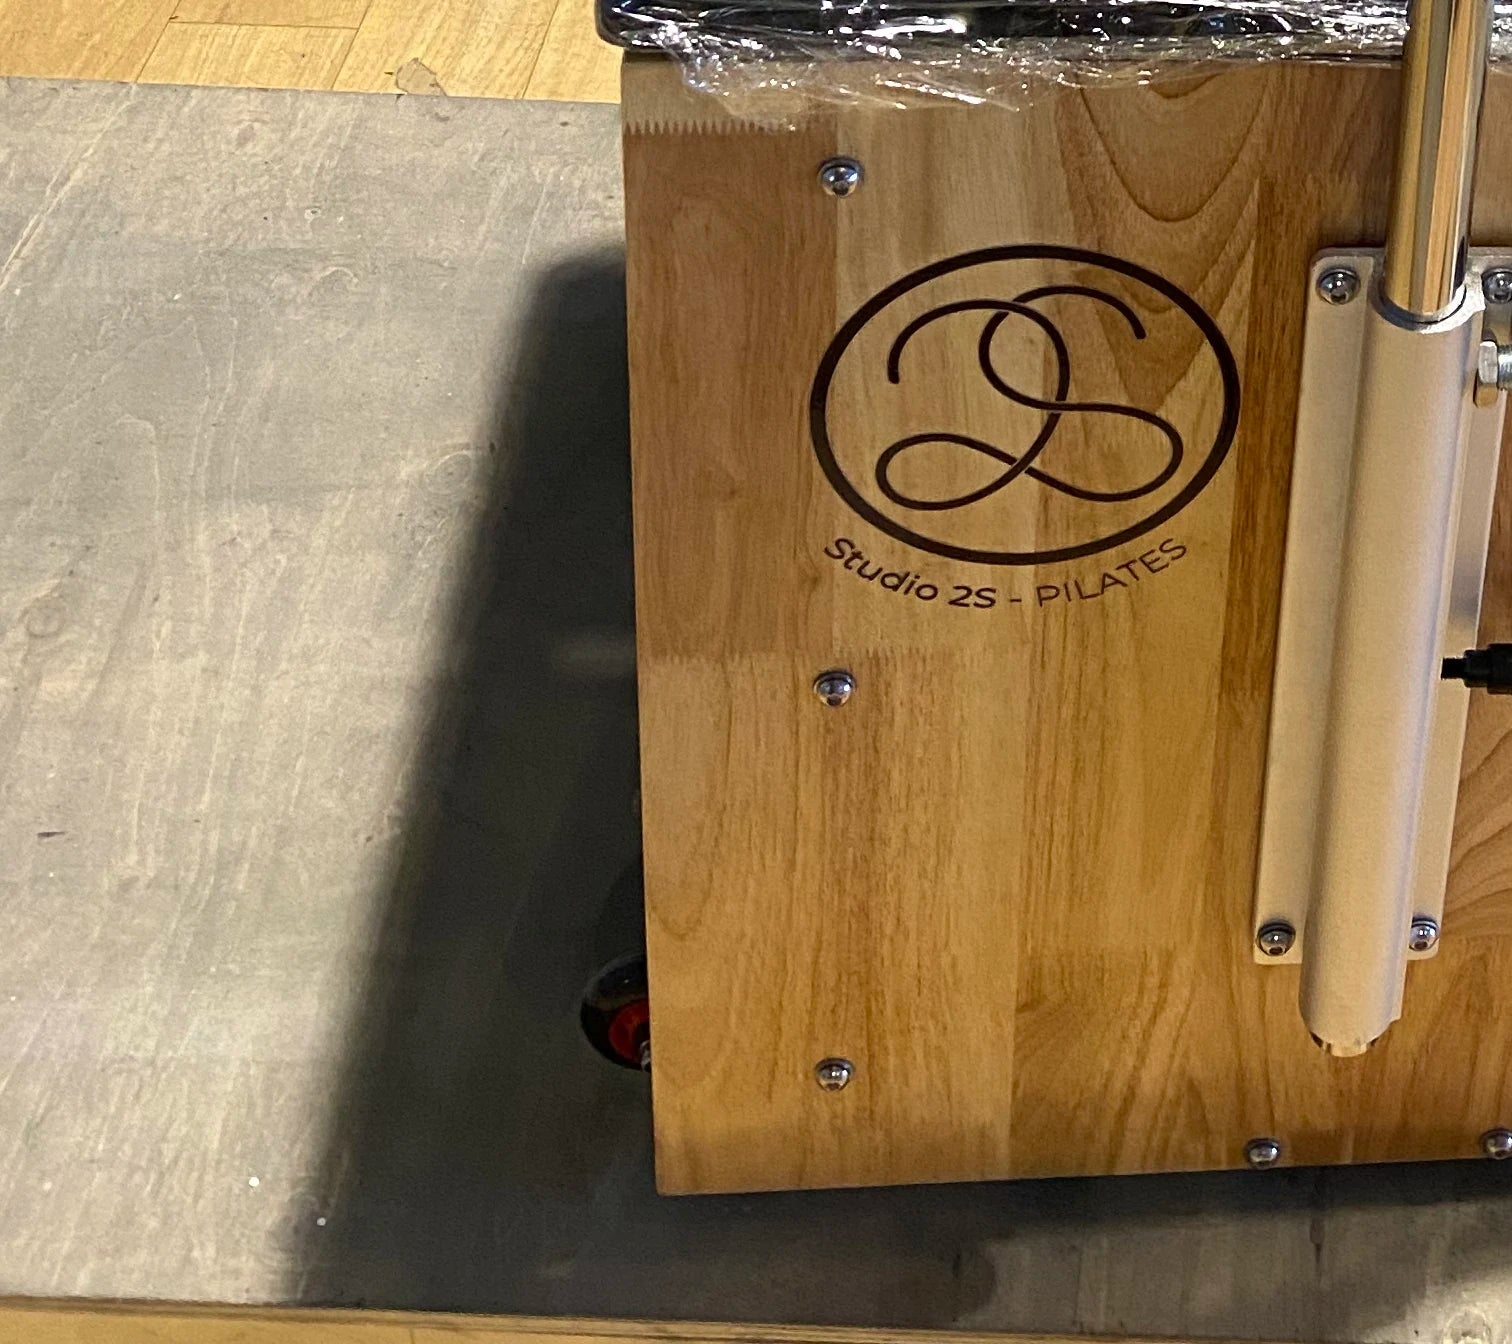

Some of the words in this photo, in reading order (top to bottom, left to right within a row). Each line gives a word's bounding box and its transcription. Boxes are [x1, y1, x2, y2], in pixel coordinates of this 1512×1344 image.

[823, 537, 939, 602] Studio
[947, 584, 998, 610] 2S
[1036, 538, 1188, 609] PILATES
